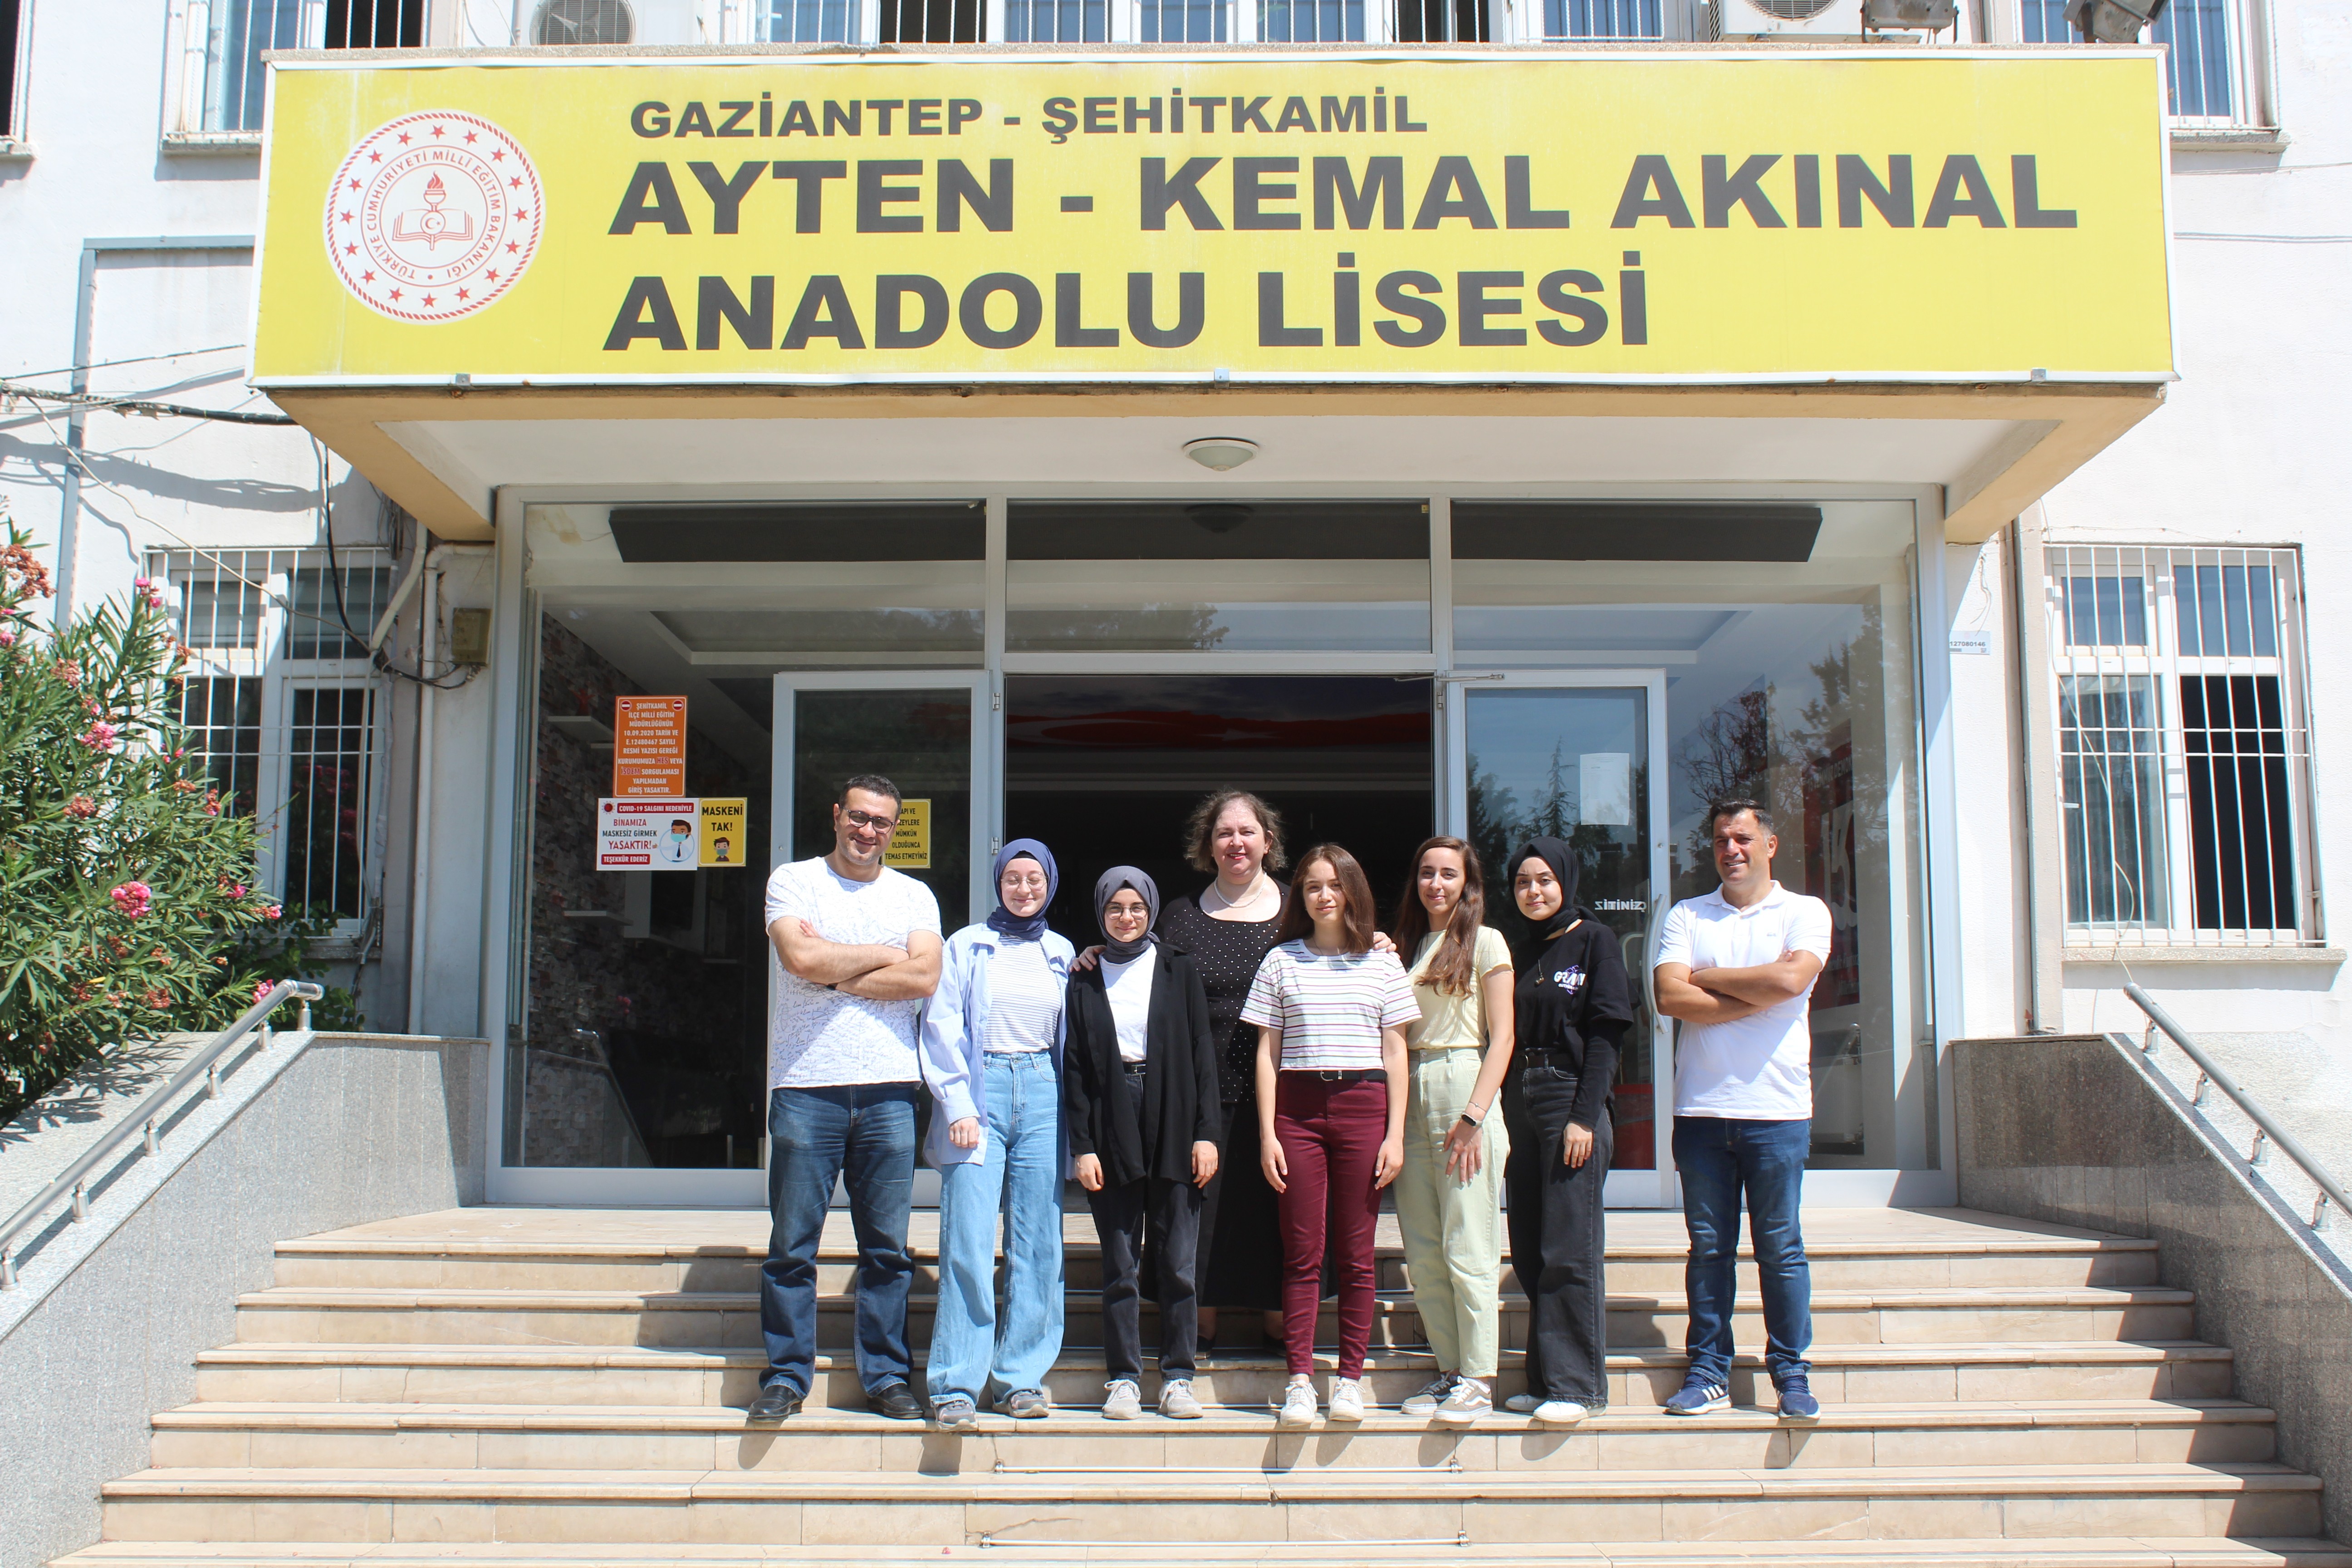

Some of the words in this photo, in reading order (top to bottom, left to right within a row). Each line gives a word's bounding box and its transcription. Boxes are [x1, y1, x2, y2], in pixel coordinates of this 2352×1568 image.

[631, 92, 982, 137] GAZİANTEP
[1042, 87, 1427, 143] ŞEHİTKAMİL
[367, 150, 427, 231] CUMHURİYETİ
[472, 165, 501, 211] EĞİTİM
[608, 159, 1013, 235] AYTEN
[1141, 156, 1569, 230] KEMAL
[1611, 155, 2077, 228] AKINAL
[446, 215, 500, 279] BAKANLIĞI
[370, 235, 416, 279] TÜRKİYE
[603, 272, 1205, 350] ANADOLU
[1258, 251, 1647, 347] LİSESİ
[637, 702, 667, 710] ŞEHİTKAMİL
[702, 804, 743, 816] MASKENİ
[613, 818, 647, 826] BİNAMIZA
[711, 822, 733, 831] TAK!
[634, 828, 657, 837] GİRMEK
[896, 829, 917, 837] MÜMKÜN
[608, 840, 652, 850] YASAKTIR!
[604, 855, 629, 864] TEŞEKKÜR
